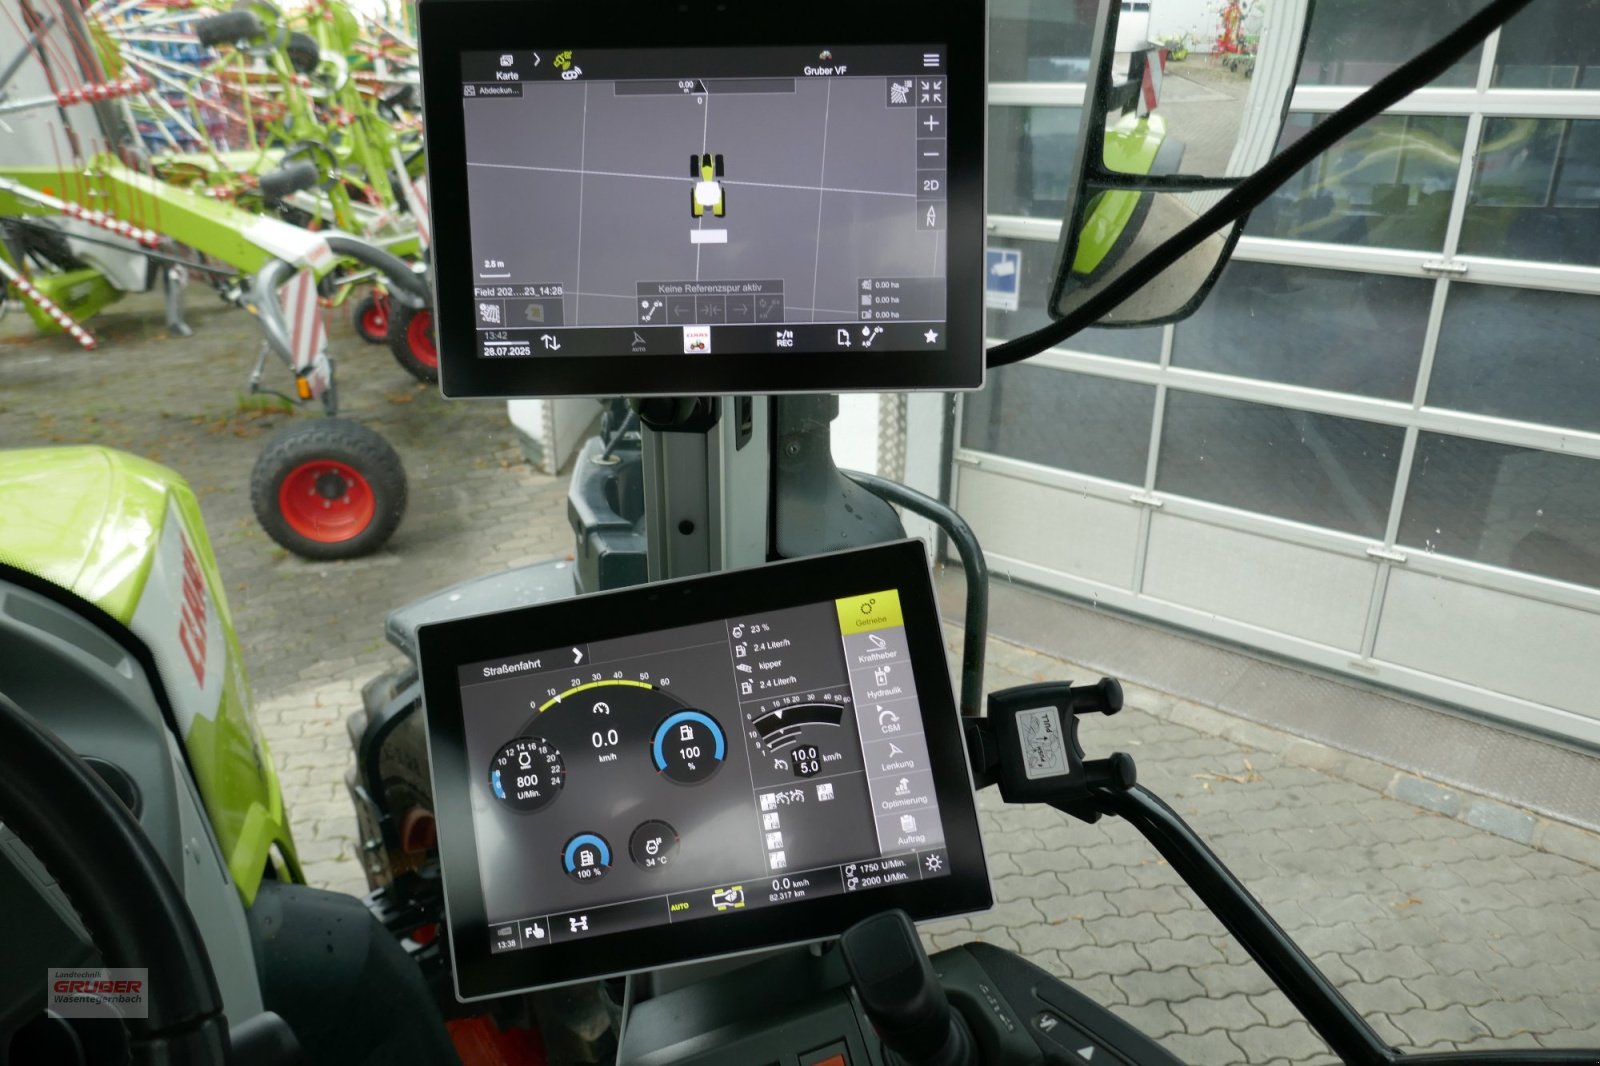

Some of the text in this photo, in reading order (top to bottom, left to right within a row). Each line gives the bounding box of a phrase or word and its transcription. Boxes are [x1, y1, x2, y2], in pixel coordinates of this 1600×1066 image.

[496, 71, 519, 80] Karte
[804, 66, 847, 76] Gruber VF
[924, 180, 939, 191] 2D
[474, 287, 496, 297] Field
[658, 282, 762, 294] Keine Referenzspur aktiv
[484, 332, 508, 340] 13:42
[776, 339, 793, 347] REC
[484, 346, 530, 356] 28.07.2025
[856, 616, 888, 627] Getriebe
[750, 625, 761, 634] 23
[754, 638, 790, 652] 2.4 Liter/h
[858, 650, 898, 664] Kraftheber
[483, 659, 542, 678] Straßenfahrt
[758, 660, 782, 670] kipper
[592, 673, 602, 682] 30
[613, 671, 624, 680] 40
[640, 672, 650, 680] 50
[571, 678, 581, 687] 20
[660, 678, 670, 686] 60
[760, 676, 797, 689] 2.4 Liter/h
[547, 688, 556, 696] 10
[866, 686, 902, 700] Hydraulik
[530, 701, 536, 709] 0
[772, 700, 780, 708] 10
[881, 723, 901, 734] CSM
[1042, 714, 1053, 734] PULL
[592, 729, 619, 748] 0.0
[516, 743, 526, 751] 14
[528, 742, 537, 750] 16
[538, 746, 548, 754] 18
[506, 748, 515, 757] 12
[599, 752, 618, 762] km/h
[680, 746, 700, 760] 100
[792, 748, 842, 762] 10.0 km/h
[498, 758, 507, 766] 10
[546, 754, 556, 762] 20
[550, 765, 560, 774] 22
[688, 762, 696, 770] %
[800, 760, 819, 774] 5.0
[881, 760, 914, 772] Lenkung
[516, 774, 538, 788] 800
[550, 777, 560, 786] 24
[517, 790, 541, 800] U/Min.
[882, 796, 928, 810] Optimierung
[897, 834, 926, 846] Auftrag
[645, 856, 667, 868] 34 °C
[860, 860, 906, 874] 1750 U/Min.
[577, 867, 602, 879] 100 %
[862, 872, 908, 886] 2000 U/Min.
[772, 878, 810, 891] 0.0 km/h
[794, 890, 806, 898] km
[670, 902, 690, 912] AUTO
[497, 939, 516, 950] 13:38
